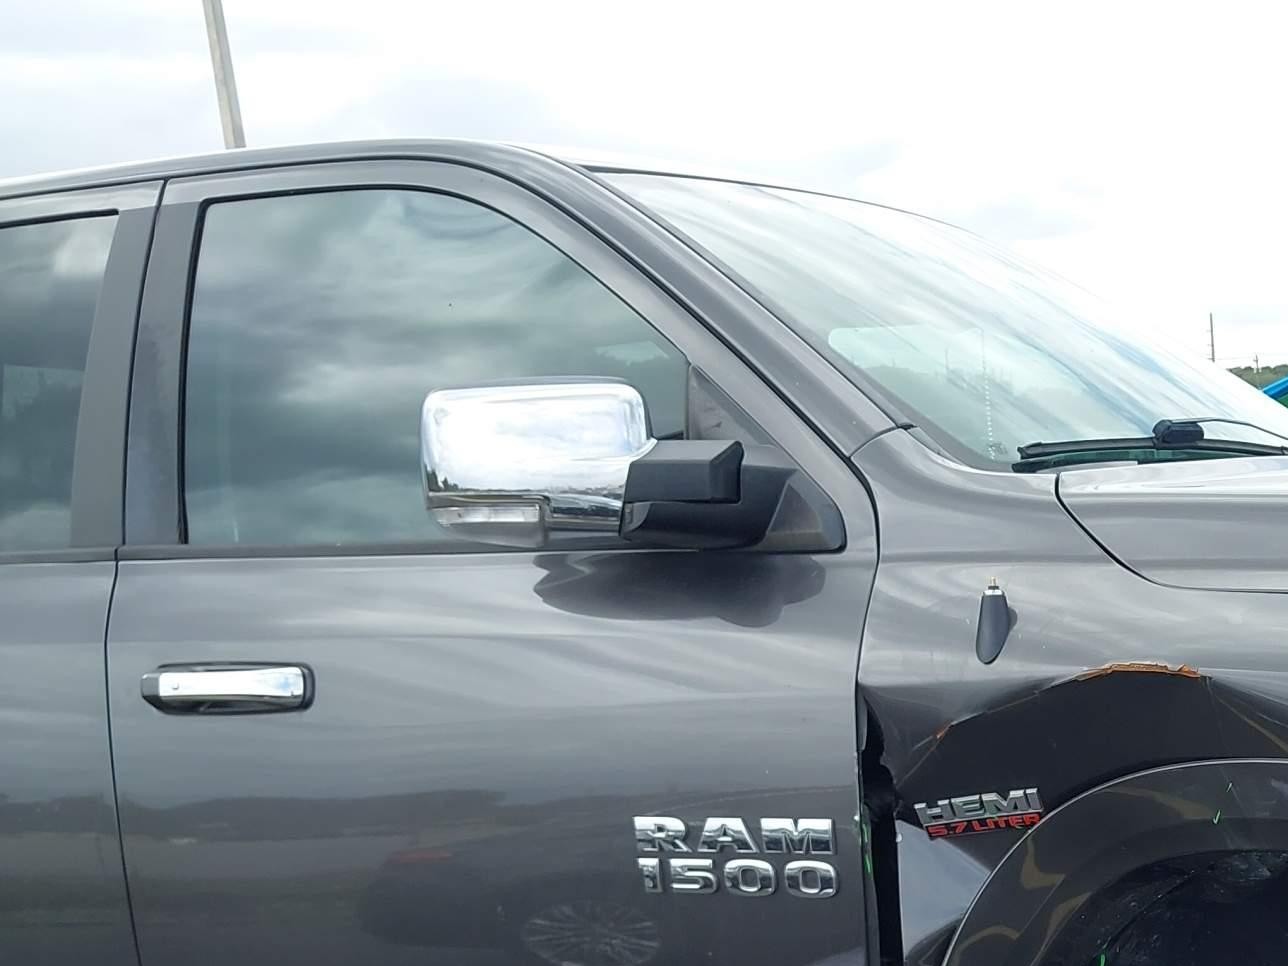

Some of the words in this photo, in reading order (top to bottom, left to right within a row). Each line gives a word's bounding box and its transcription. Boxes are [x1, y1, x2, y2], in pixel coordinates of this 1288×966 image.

[913, 787, 1042, 826] HEMI
[927, 821, 968, 837] 5.7
[972, 813, 1041, 832] LITER
[632, 816, 835, 854] RAM
[636, 857, 838, 898] 1500
